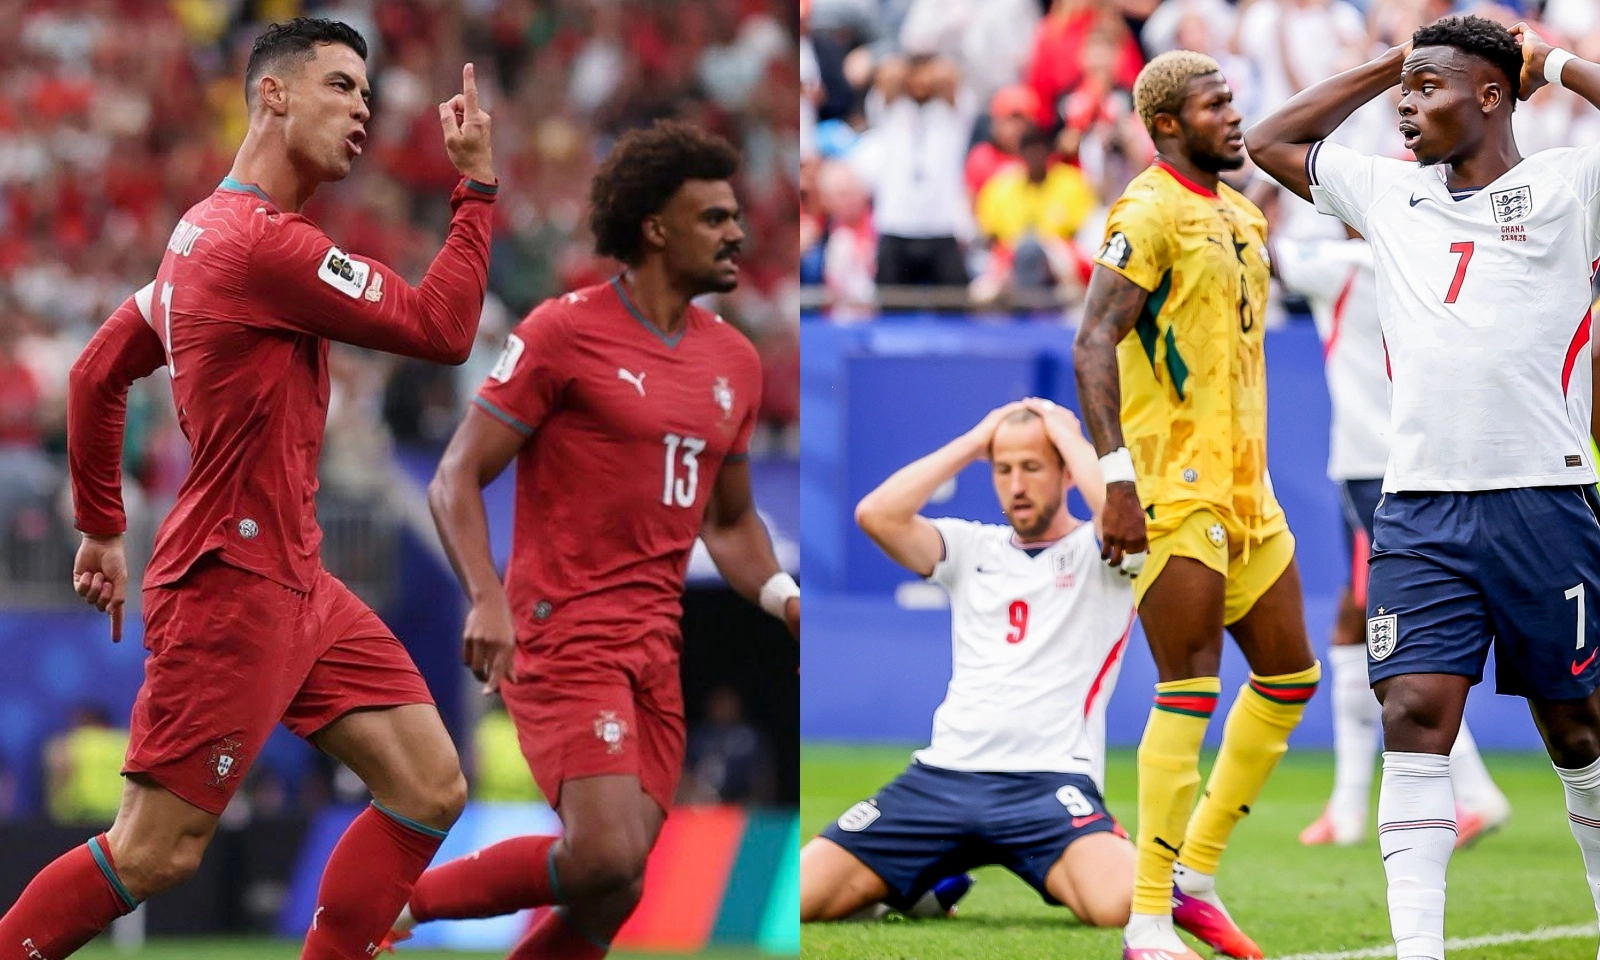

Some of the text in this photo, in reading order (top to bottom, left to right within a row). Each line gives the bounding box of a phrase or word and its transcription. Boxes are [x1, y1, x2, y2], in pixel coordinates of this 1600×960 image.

[1501, 225, 1525, 233] GHANA
[1444, 241, 1474, 304] 7
[1240, 274, 1253, 333] 8
[663, 433, 706, 508] 13
[1006, 600, 1028, 644] 9
[1564, 582, 1585, 650] 7
[1055, 784, 1094, 817] 9
